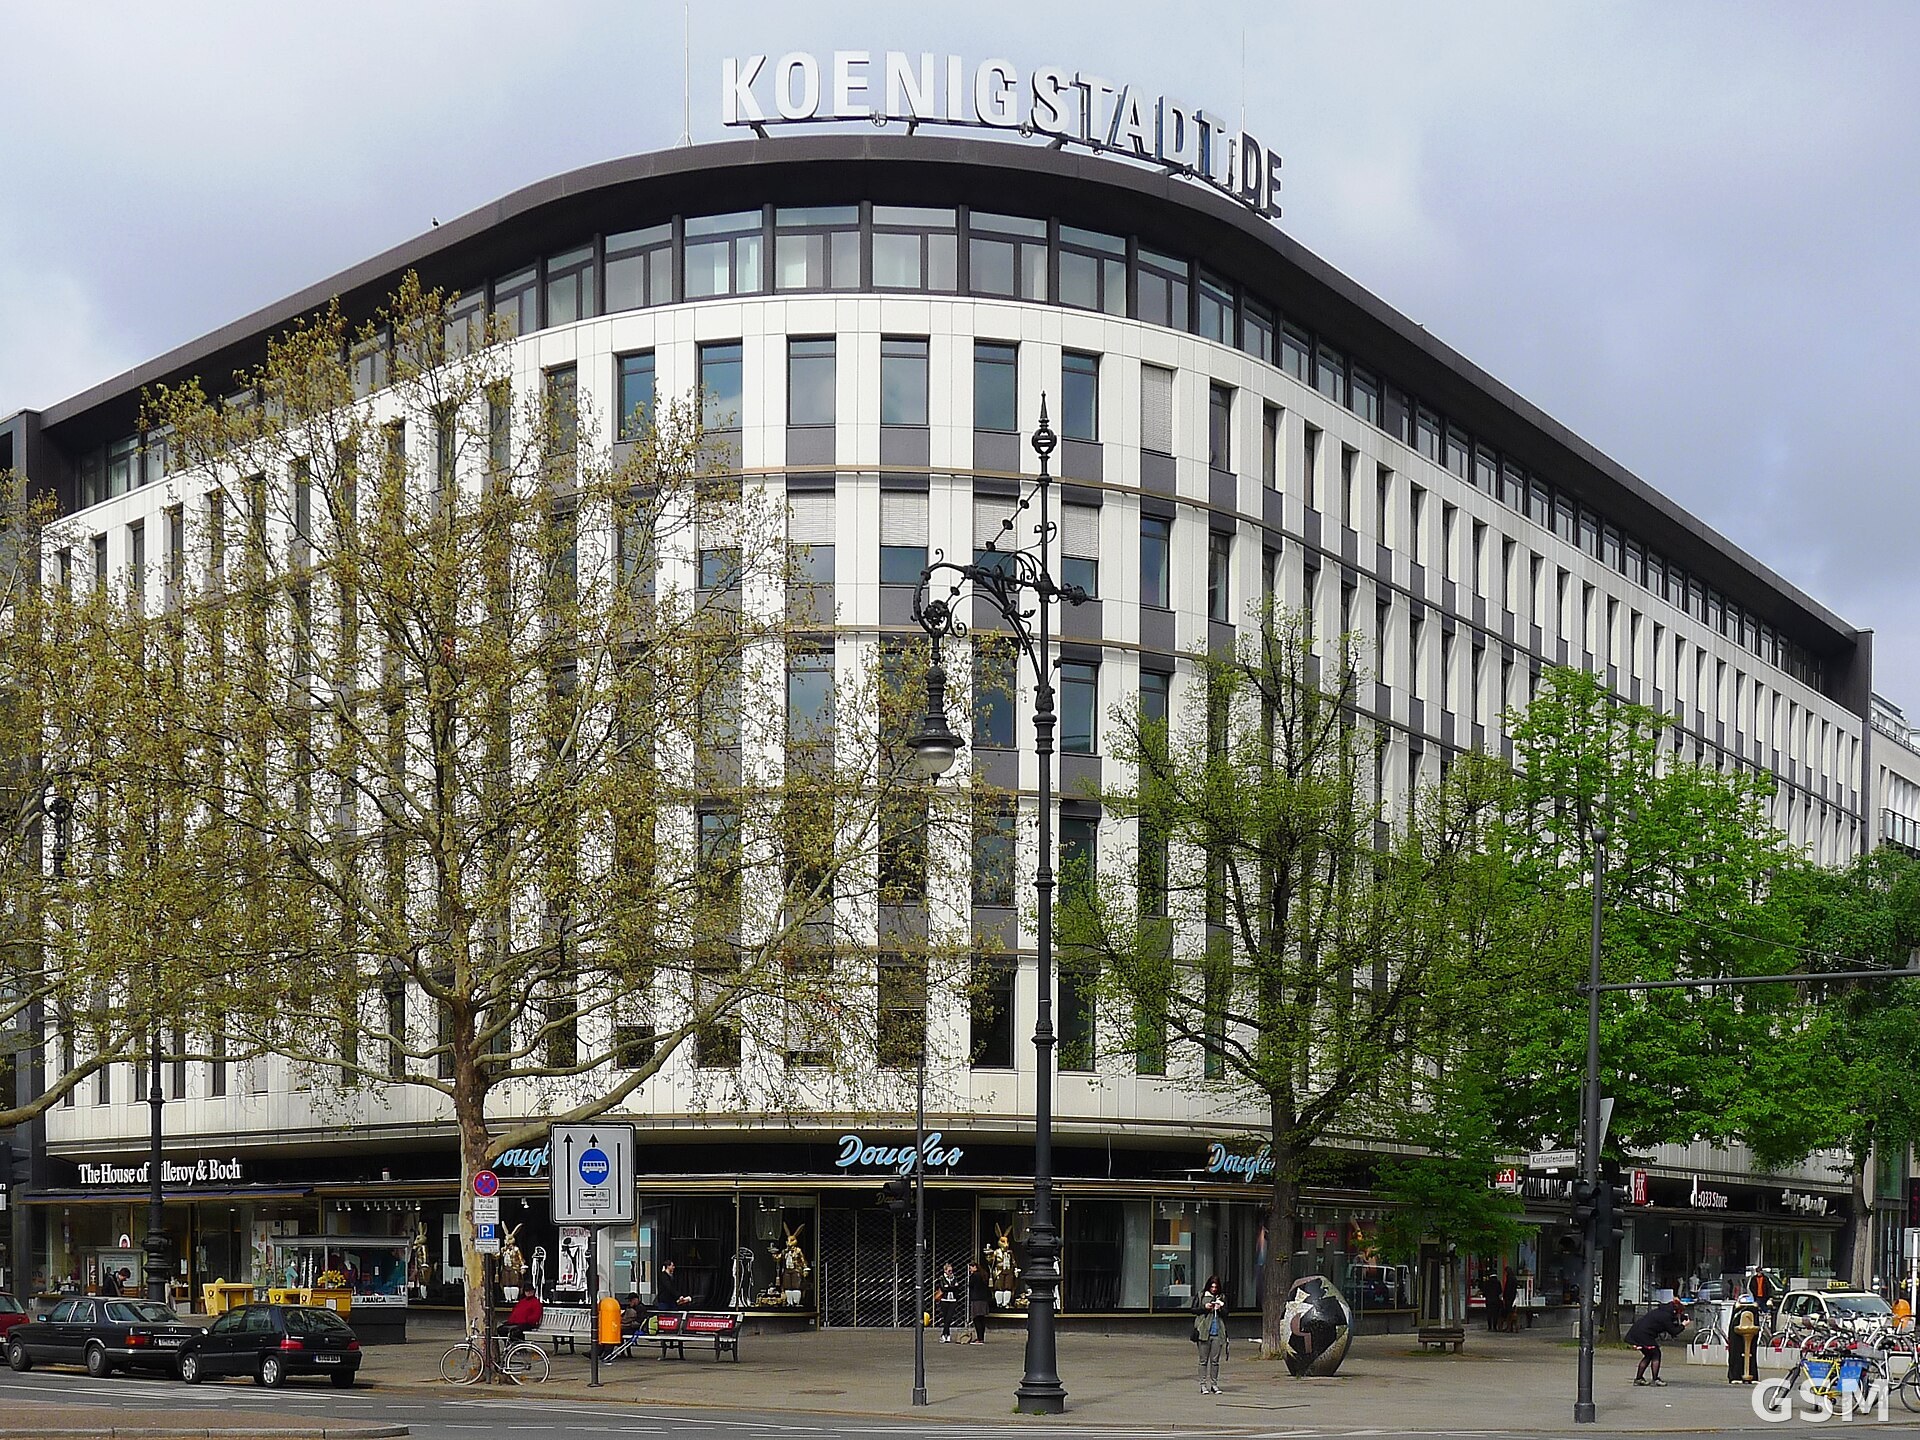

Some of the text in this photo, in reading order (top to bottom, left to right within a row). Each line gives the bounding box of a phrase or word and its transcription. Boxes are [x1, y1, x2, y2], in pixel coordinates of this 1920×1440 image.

[835, 1132, 964, 1175] Douglas
[78, 1157, 242, 1187] The House of illeroy & Boch
[1712, 1191, 1728, 1208] Store
